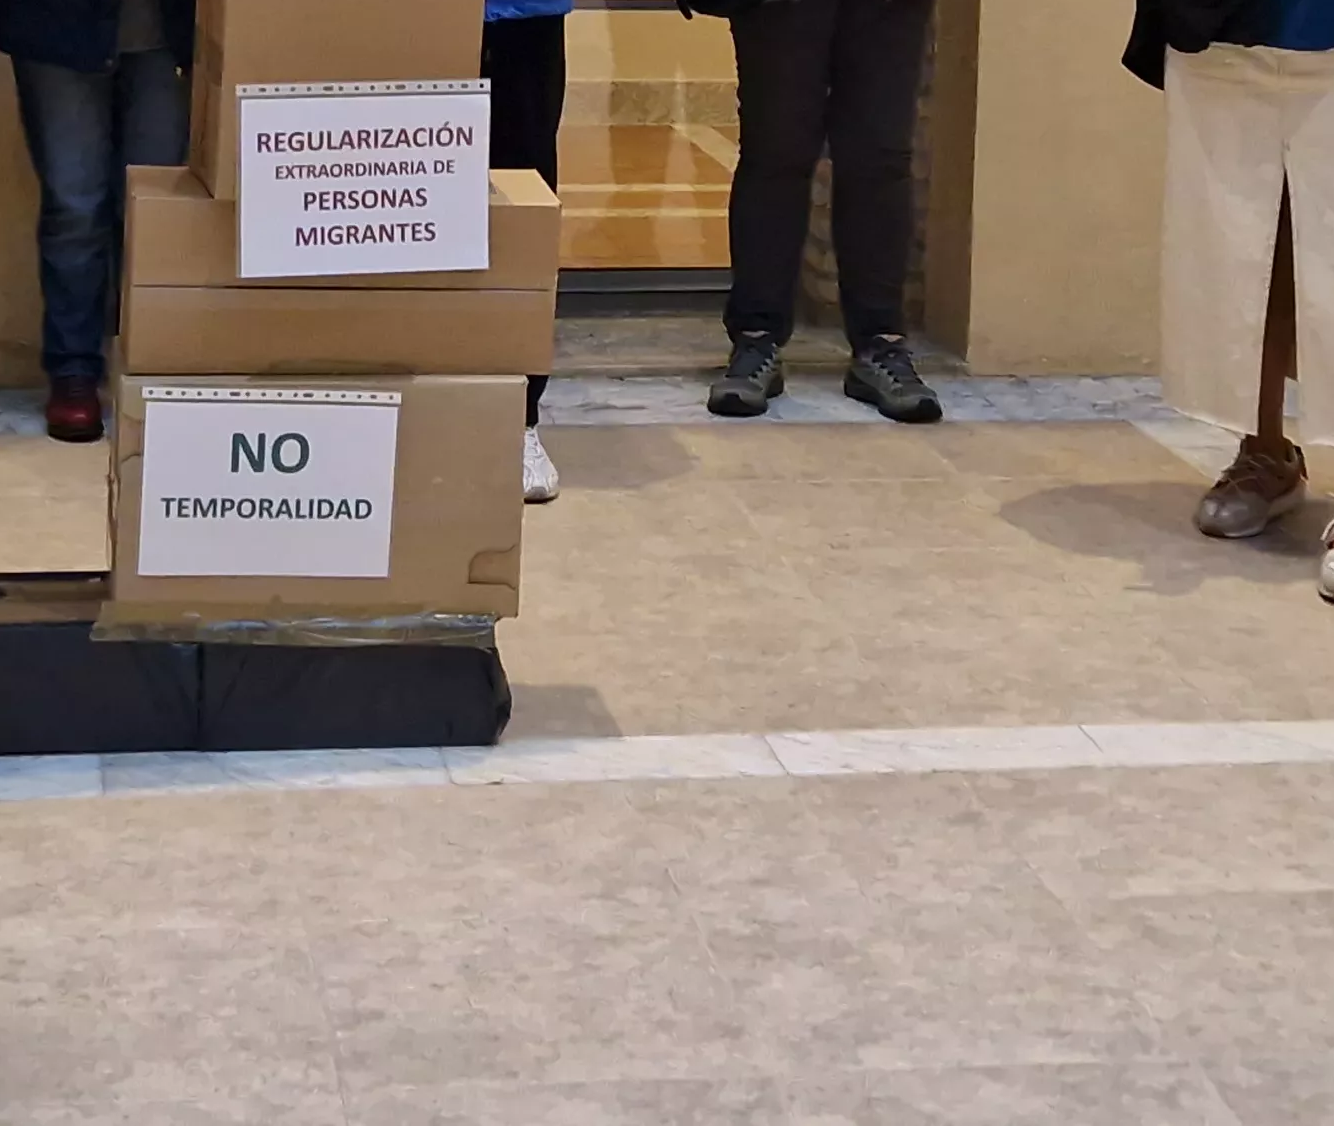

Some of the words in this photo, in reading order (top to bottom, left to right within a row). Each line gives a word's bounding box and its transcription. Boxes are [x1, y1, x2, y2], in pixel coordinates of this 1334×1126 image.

[256, 121, 474, 154] REGULARIZACIÓN
[275, 160, 428, 181] EXTRAORDINARIA
[433, 159, 456, 175] DE
[303, 187, 428, 212] PERSONAS
[295, 221, 437, 247] MIGRANTES
[230, 432, 310, 474] NO
[160, 497, 373, 520] TEMPORALIDAD
